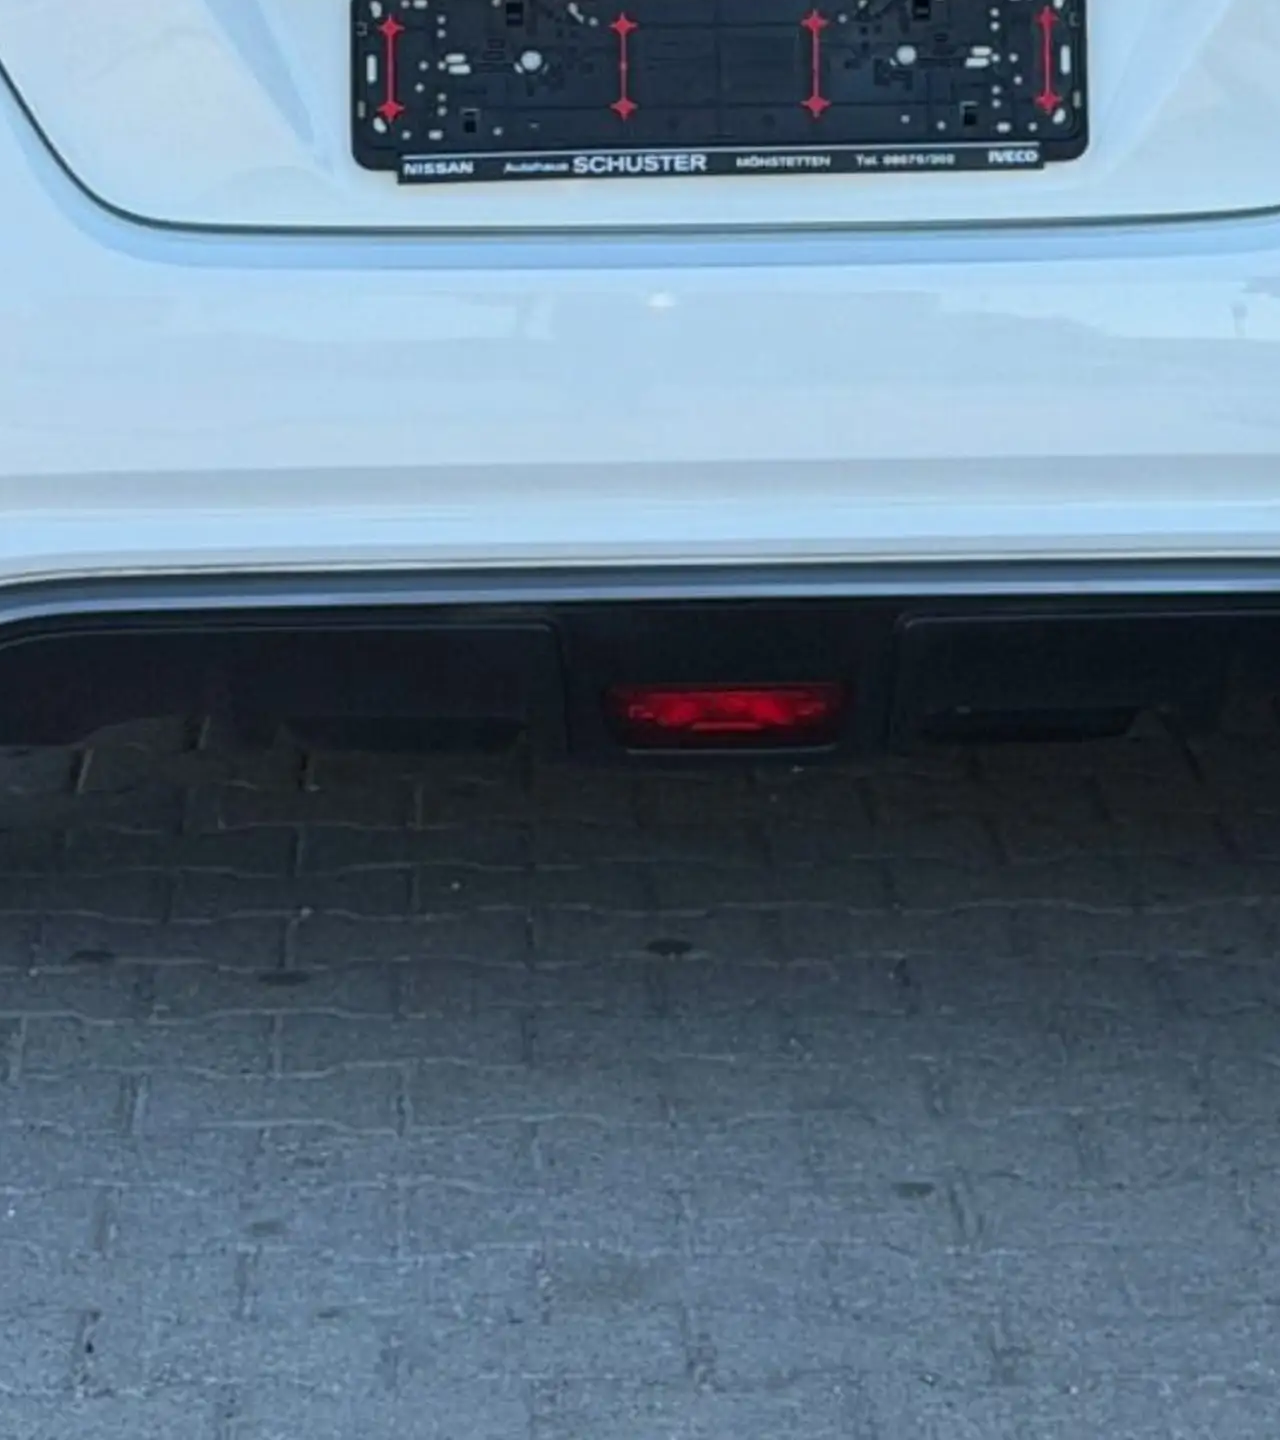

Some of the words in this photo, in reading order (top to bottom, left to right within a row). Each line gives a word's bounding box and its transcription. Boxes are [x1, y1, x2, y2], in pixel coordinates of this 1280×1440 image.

[403, 162, 474, 175] NISSAN
[573, 155, 707, 173] SCHUSTER
[988, 149, 1039, 163] IVECO
